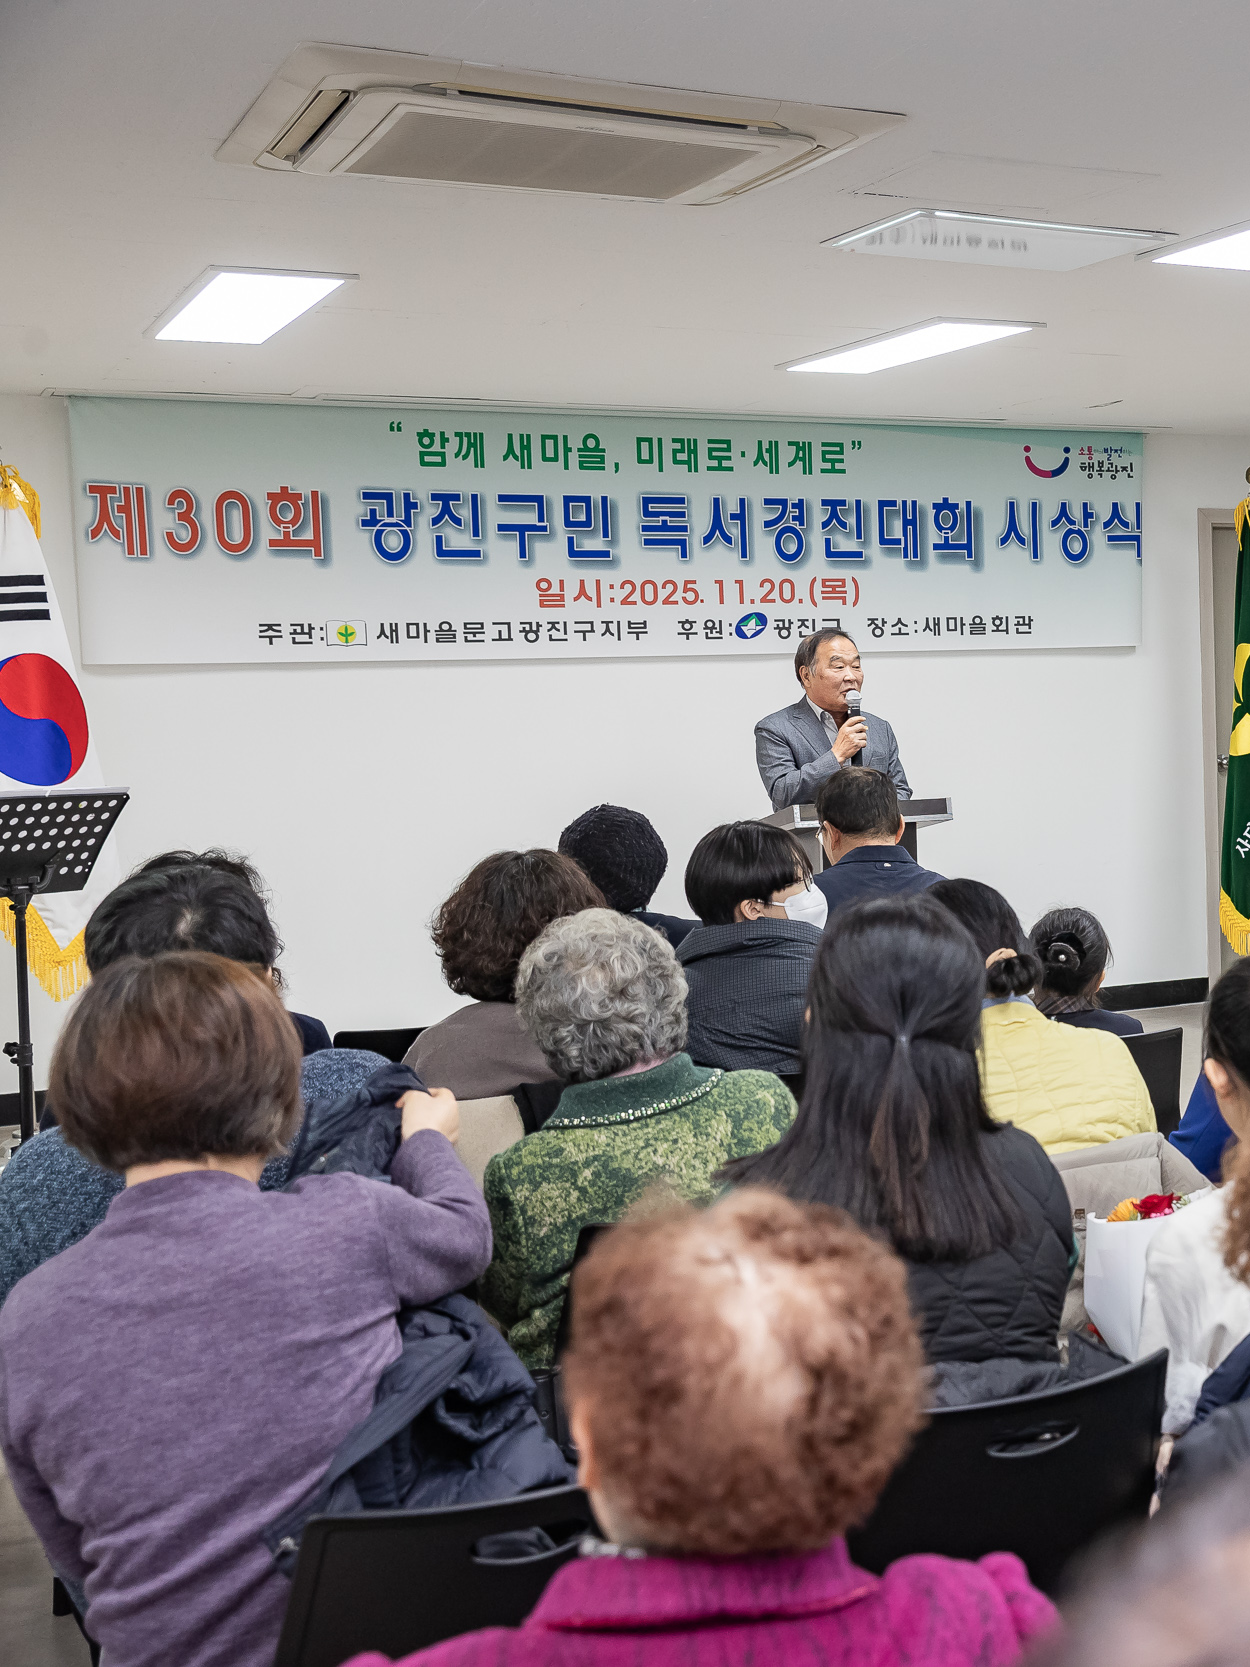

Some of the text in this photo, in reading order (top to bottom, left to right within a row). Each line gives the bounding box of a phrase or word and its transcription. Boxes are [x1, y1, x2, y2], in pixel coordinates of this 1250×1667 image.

[502, 433, 620, 473] 새마을,
[1079, 460, 1134, 480] 행복광진
[86, 482, 1142, 563] 제30회 광진구민 독서경진대회 시상식
[257, 622, 325, 646] 주관:
[376, 620, 648, 644] 새마을문고광진구지부
[677, 618, 733, 641] 후원:
